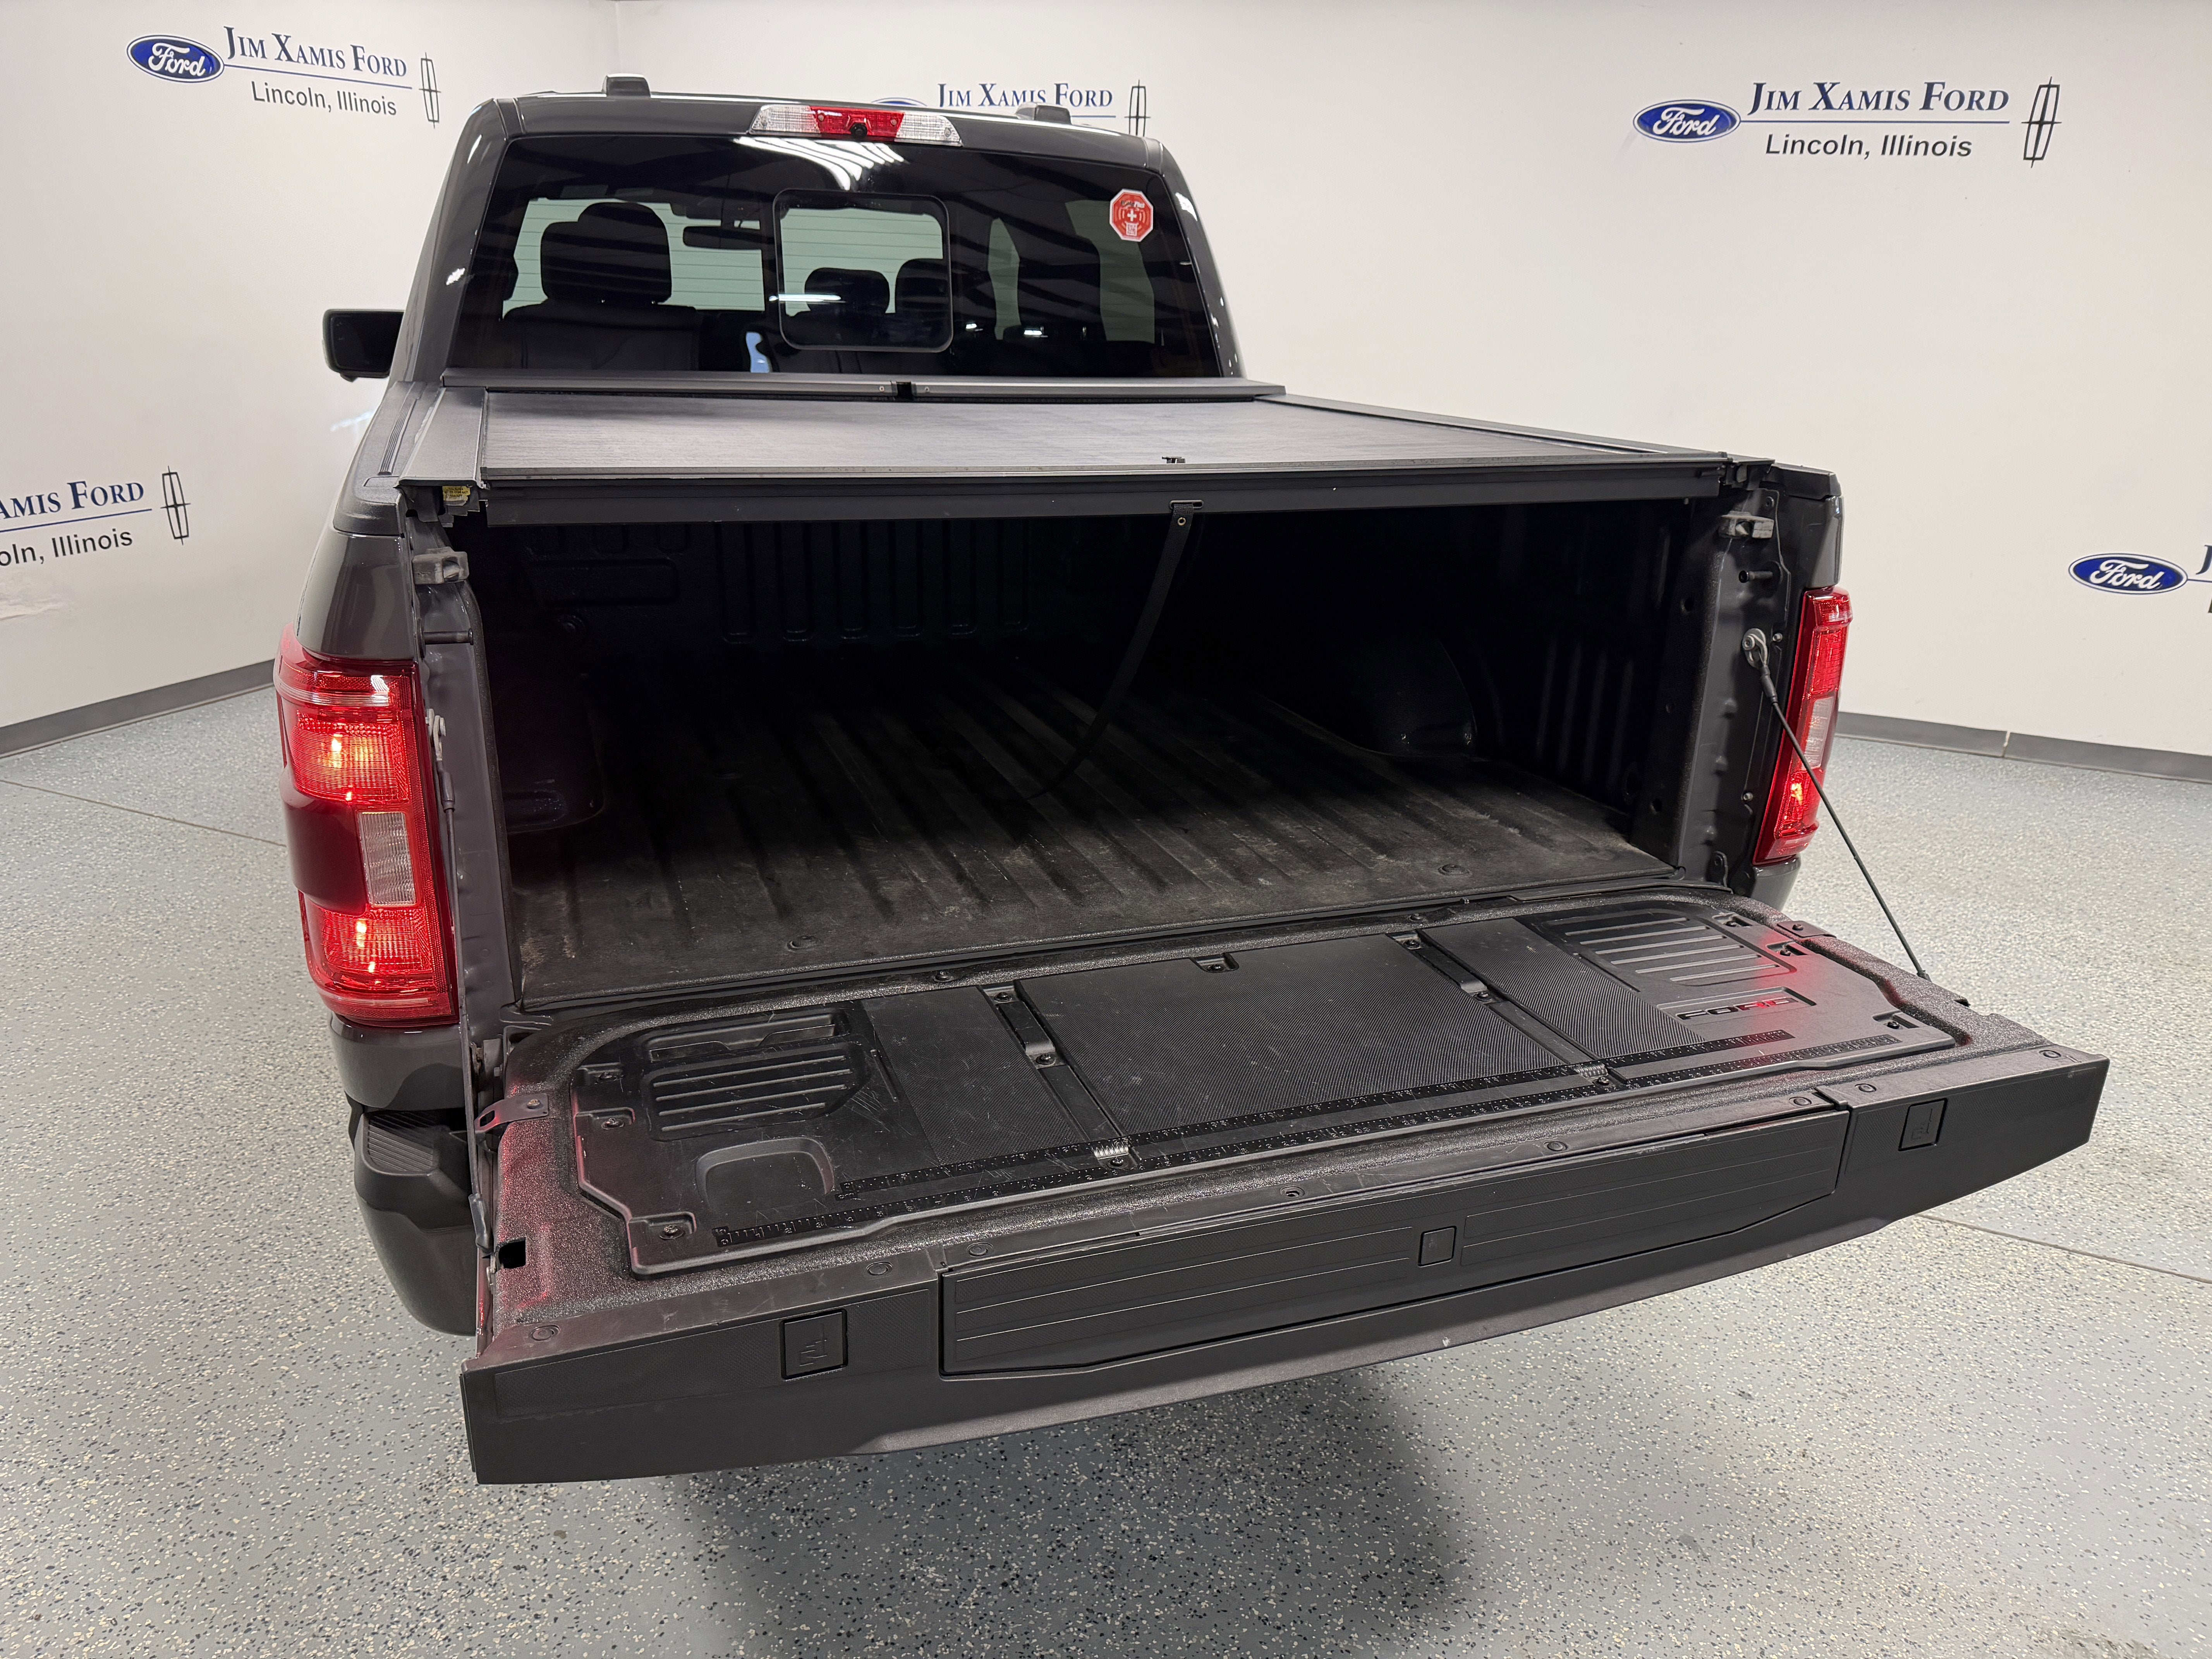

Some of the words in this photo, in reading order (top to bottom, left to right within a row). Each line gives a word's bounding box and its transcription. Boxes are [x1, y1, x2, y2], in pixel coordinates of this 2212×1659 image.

[148, 43, 206, 76] Ford
[251, 81, 331, 112] Lincoln,
[337, 91, 397, 115] Illinois
[1653, 107, 1720, 136] Ford
[1765, 134, 1870, 160] Lincoln,
[1881, 134, 1972, 156] Illinois
[52, 528, 132, 557] Illinois
[2090, 559, 2165, 589] Ford
